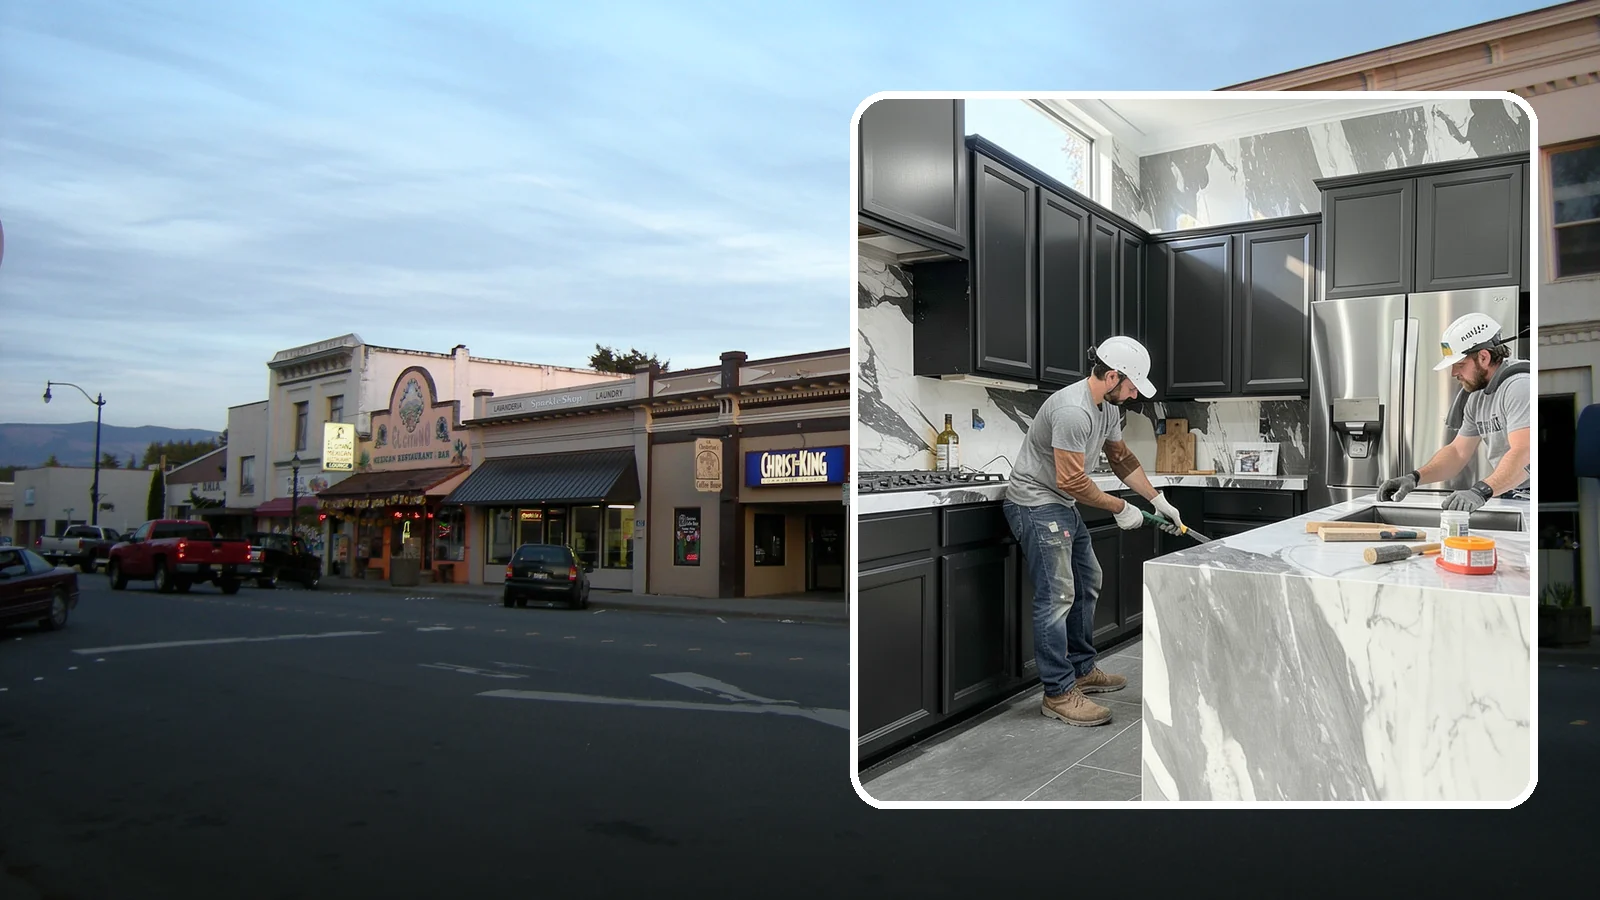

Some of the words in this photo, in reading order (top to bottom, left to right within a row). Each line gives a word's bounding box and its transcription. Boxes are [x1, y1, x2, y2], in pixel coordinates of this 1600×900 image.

[562, 395, 583, 404] Shop
[596, 389, 623, 400] LAUNDRY
[493, 402, 522, 412] LAVANDERIA
[373, 455, 396, 464] MEXICAN
[397, 451, 433, 462] RESTAURANT
[438, 450, 450, 459] BAR
[761, 452, 797, 478] CHRIST
[799, 450, 827, 476] KING
